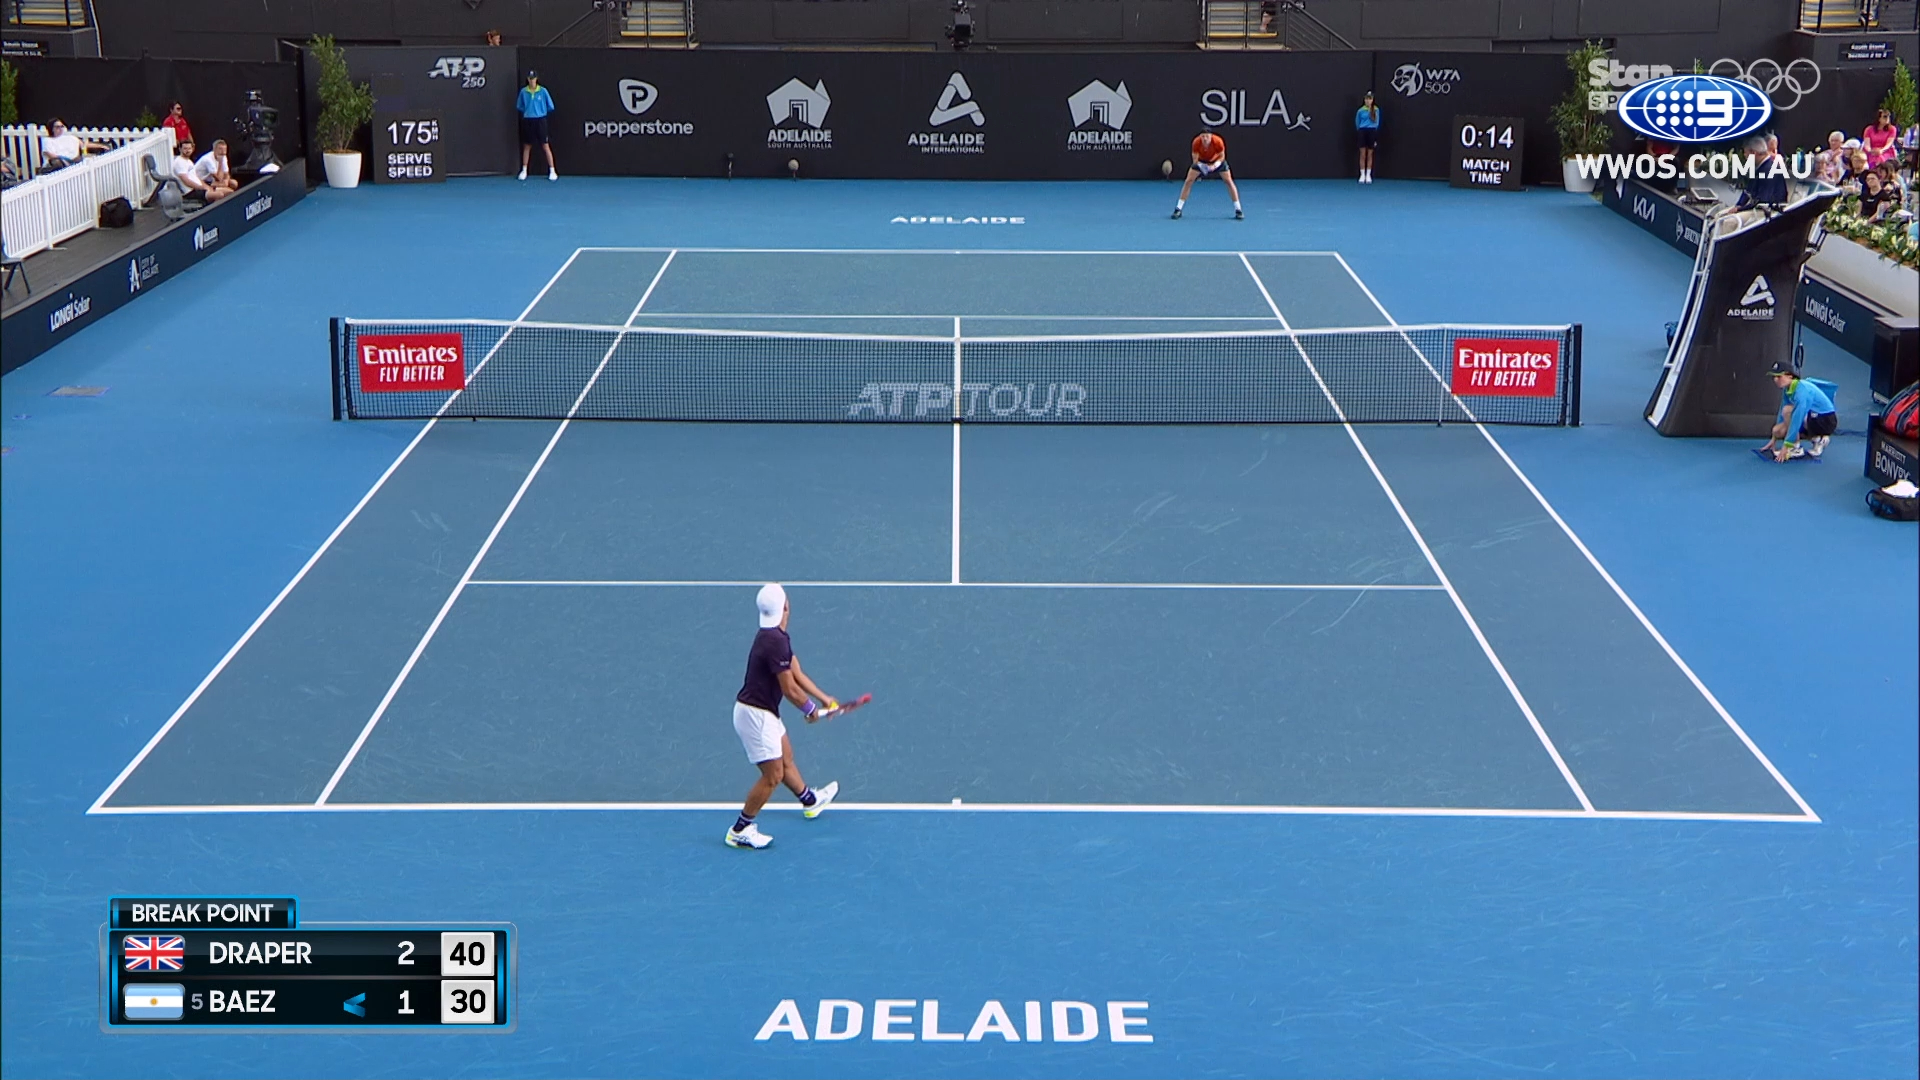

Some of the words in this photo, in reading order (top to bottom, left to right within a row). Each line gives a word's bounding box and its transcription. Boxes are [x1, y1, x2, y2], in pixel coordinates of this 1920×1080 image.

[427, 57, 485, 77] ATP
[1426, 69, 1461, 81] WTA
[462, 77, 486, 88] 250
[1425, 81, 1451, 94] 500
[1200, 89, 1291, 126] SILA
[387, 121, 432, 145] 175
[584, 119, 694, 138] pepperstone
[768, 129, 832, 142] ADELAIDE
[908, 133, 985, 146] ADELAIDE
[1068, 131, 1132, 144] ADELAIDE
[1461, 124, 1514, 149] 0:14
[793, 142, 832, 150] AUSTRALIA
[921, 145, 985, 154] INTERNATIONAL
[387, 153, 432, 165] SERVE
[1462, 158, 1510, 172] MATCH
[388, 165, 433, 178] SPEED
[1470, 171, 1502, 185] TIME
[890, 215, 1026, 225] ADELAIDE
[74, 296, 91, 318] Solar
[1727, 307, 1775, 316] ADELAIDE
[1828, 309, 1846, 333] Solar
[362, 344, 458, 365] Emirates
[1459, 347, 1552, 369] Emirates
[379, 367, 401, 383] FLY
[402, 365, 445, 383] BETTER
[1470, 370, 1491, 387] FLY
[1493, 371, 1537, 387] BETTER
[843, 383, 952, 416] ATP
[962, 383, 1087, 416] TOUR
[754, 998, 1154, 1043] ADELAIDE
